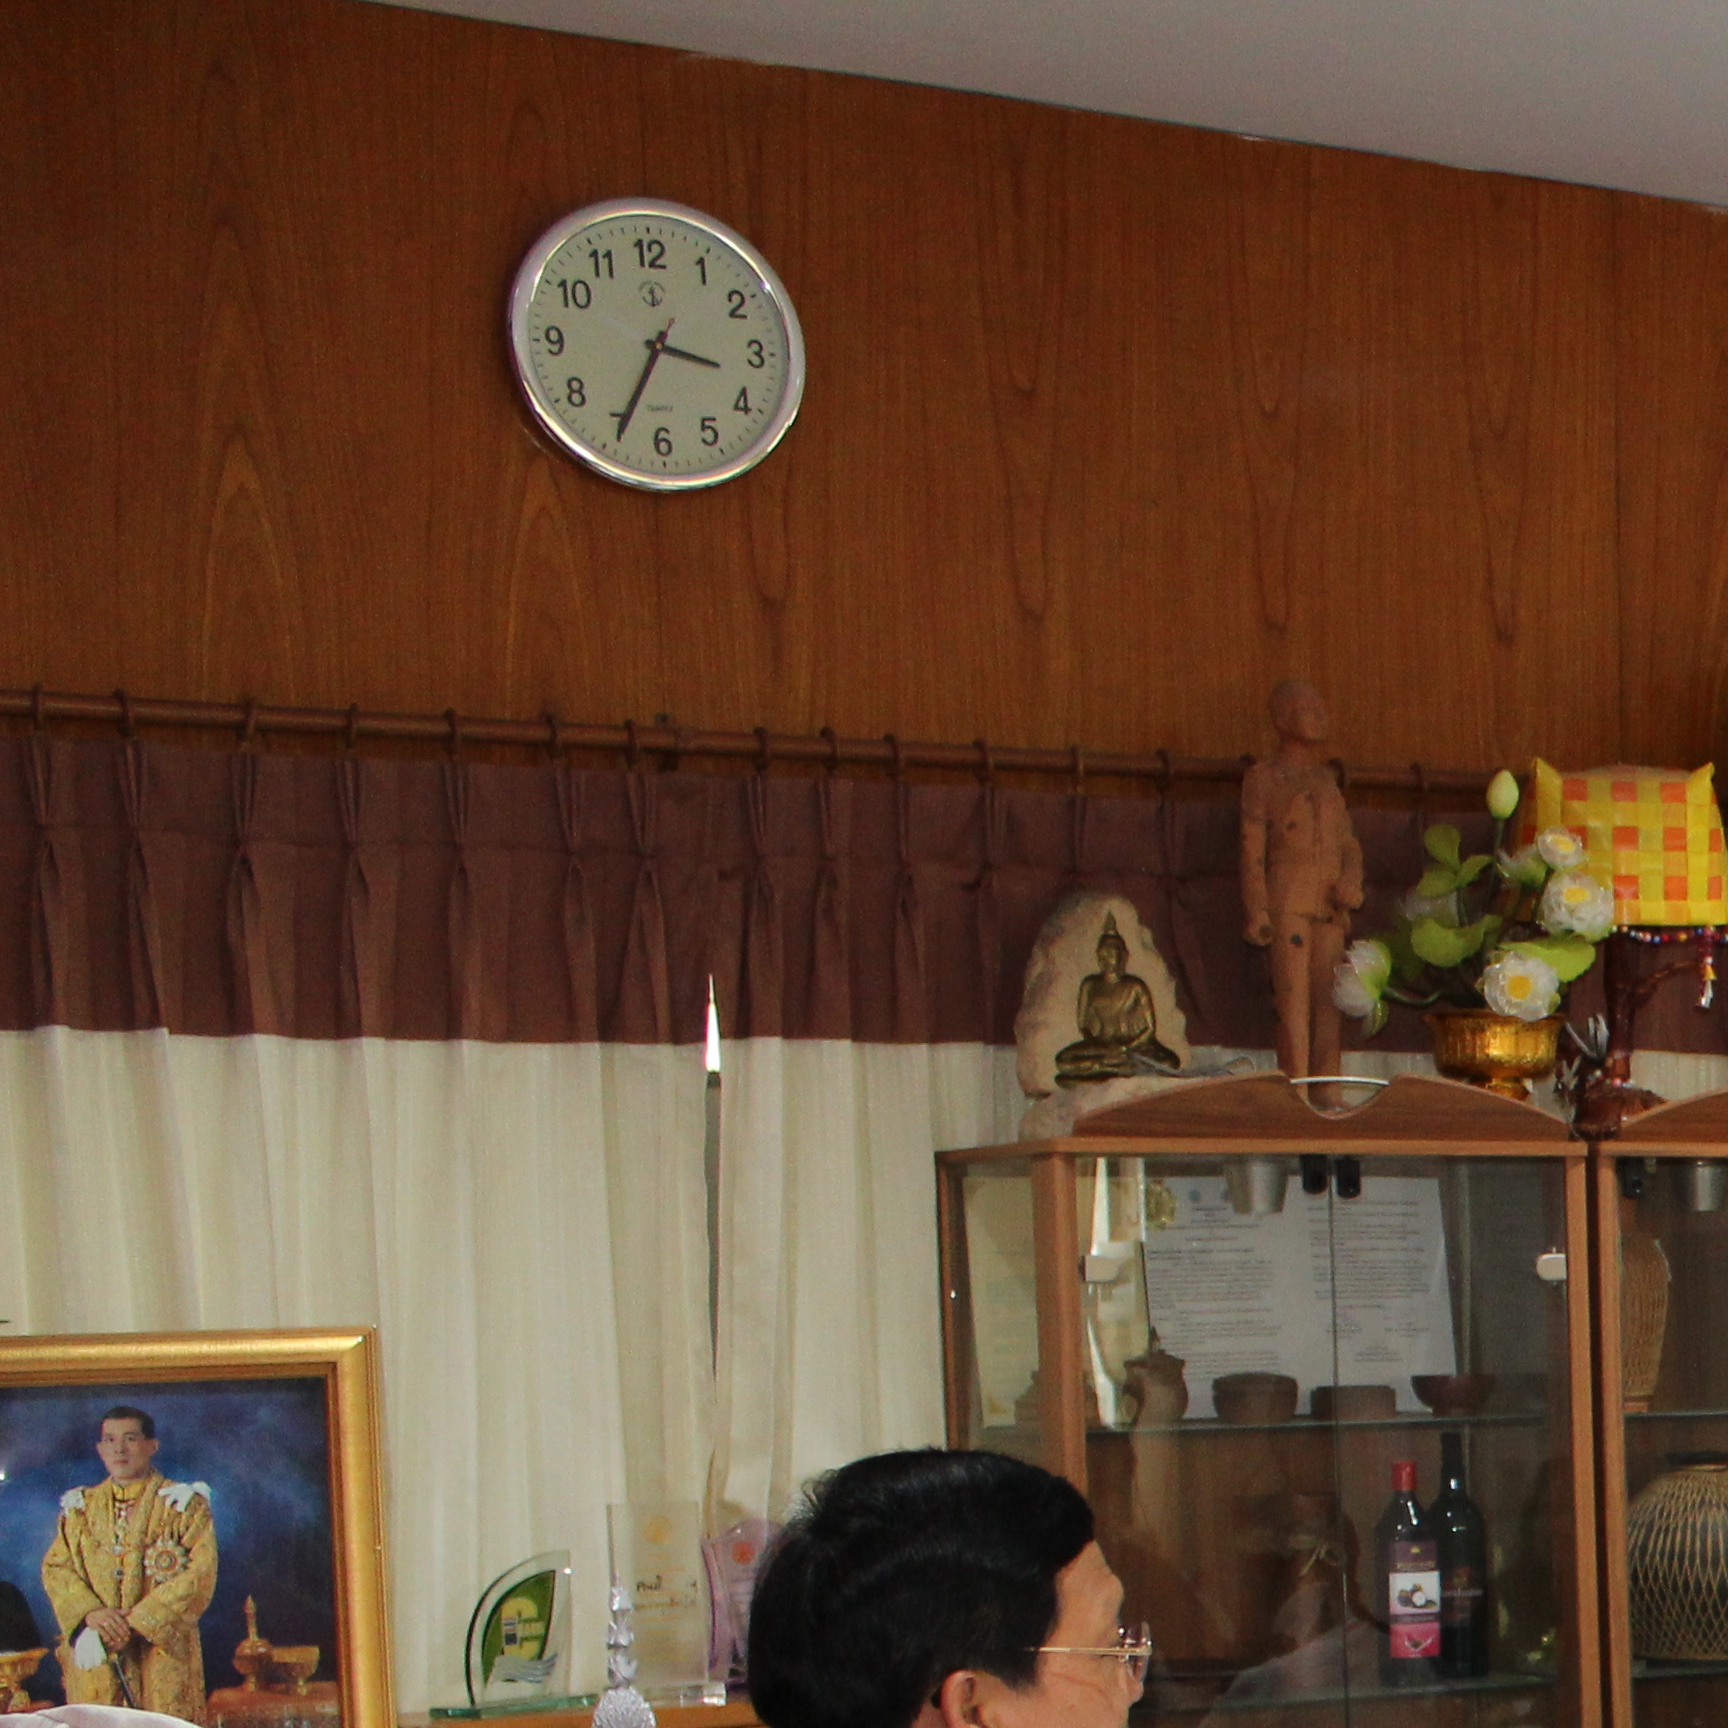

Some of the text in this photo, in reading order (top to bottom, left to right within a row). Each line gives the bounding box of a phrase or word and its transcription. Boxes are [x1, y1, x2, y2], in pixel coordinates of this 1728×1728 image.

[588, 249, 615, 279] 11
[633, 239, 667, 270] 12
[695, 257, 708, 286] 1
[558, 279, 592, 309] 10
[727, 290, 748, 319] 2
[544, 326, 565, 355] 9
[746, 339, 766, 369] 3
[566, 377, 587, 407] 8
[733, 387, 752, 415] 4
[653, 427, 673, 456] 6
[700, 417, 720, 446] 5
